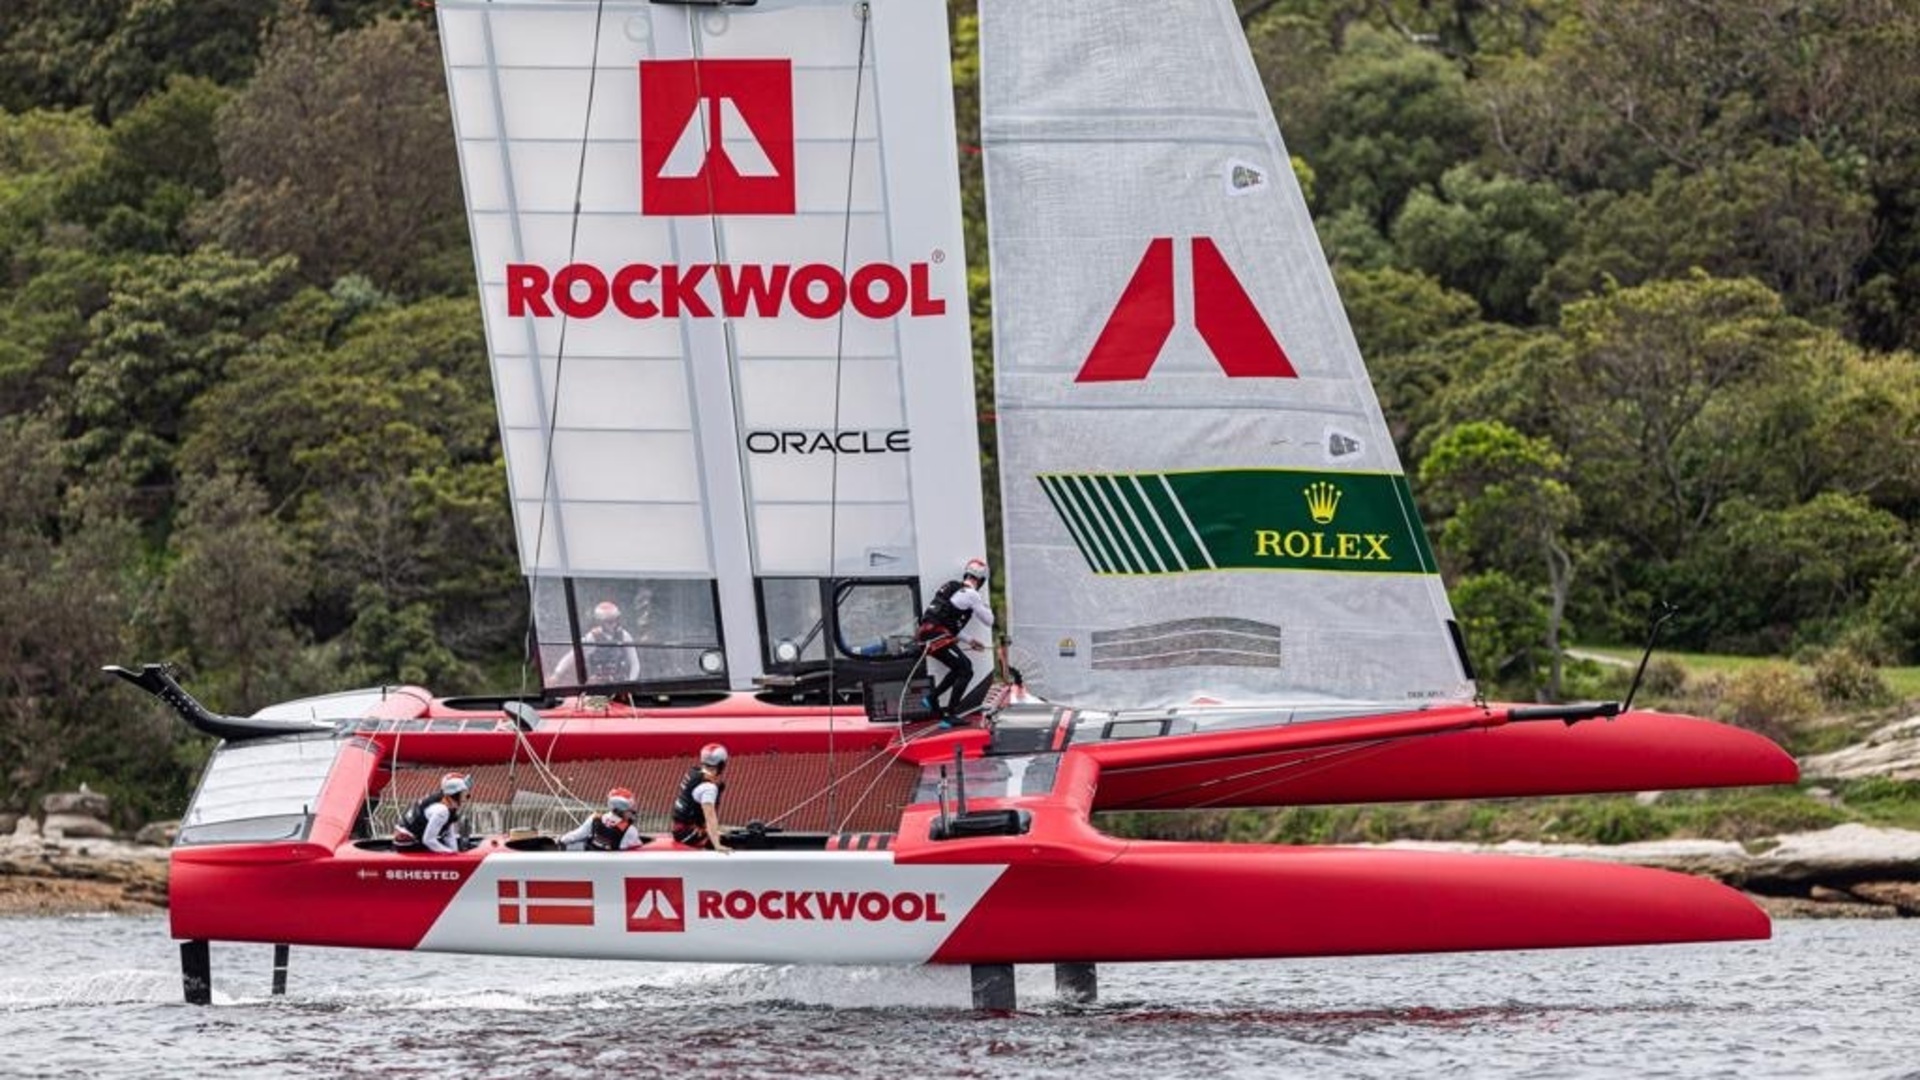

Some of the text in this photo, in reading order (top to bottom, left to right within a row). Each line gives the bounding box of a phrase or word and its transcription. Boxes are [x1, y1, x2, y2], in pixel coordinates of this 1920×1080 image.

[746, 430, 912, 454] ORACLE
[1254, 529, 1393, 561] ROLEX
[385, 869, 460, 880] SEHESTED
[697, 889, 946, 922] ROCKWOOL
